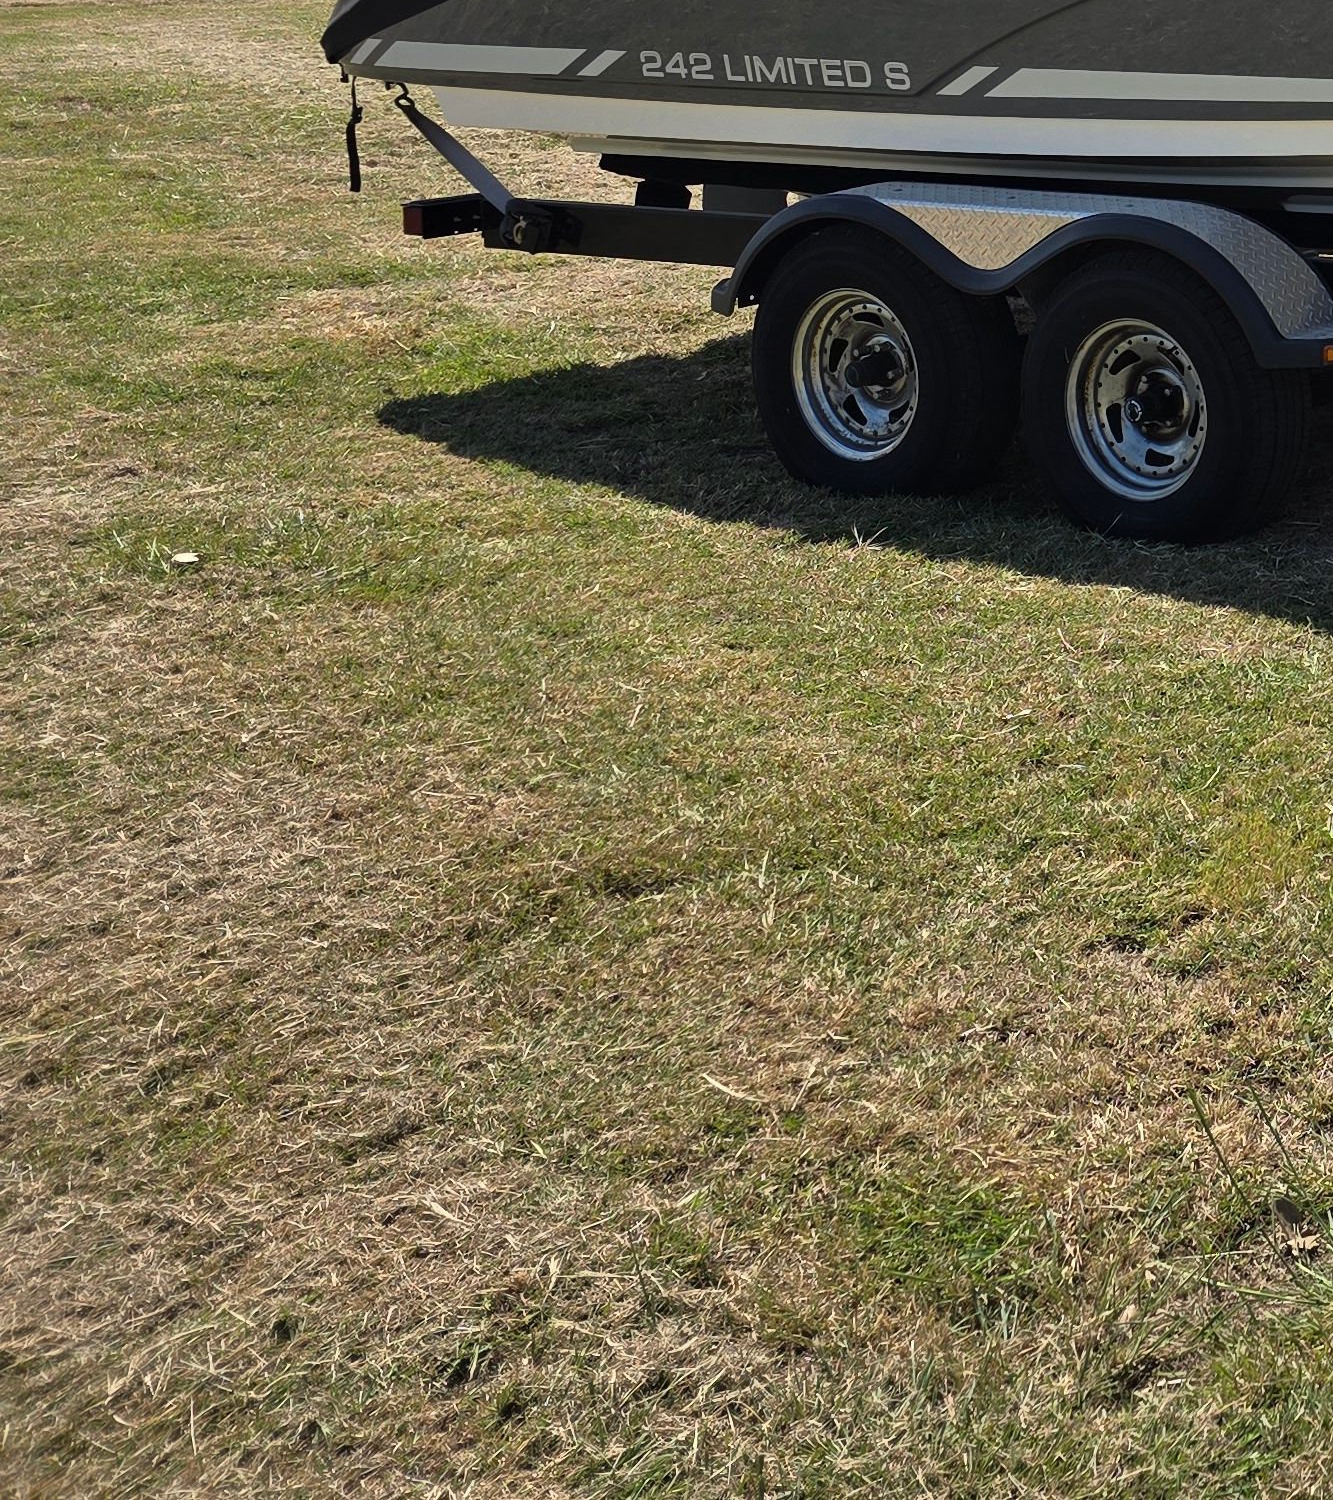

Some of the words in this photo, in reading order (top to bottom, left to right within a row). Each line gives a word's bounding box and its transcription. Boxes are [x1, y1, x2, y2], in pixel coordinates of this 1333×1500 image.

[639, 50, 714, 80] 242
[723, 54, 872, 88] LIMITED
[884, 61, 911, 91] S
